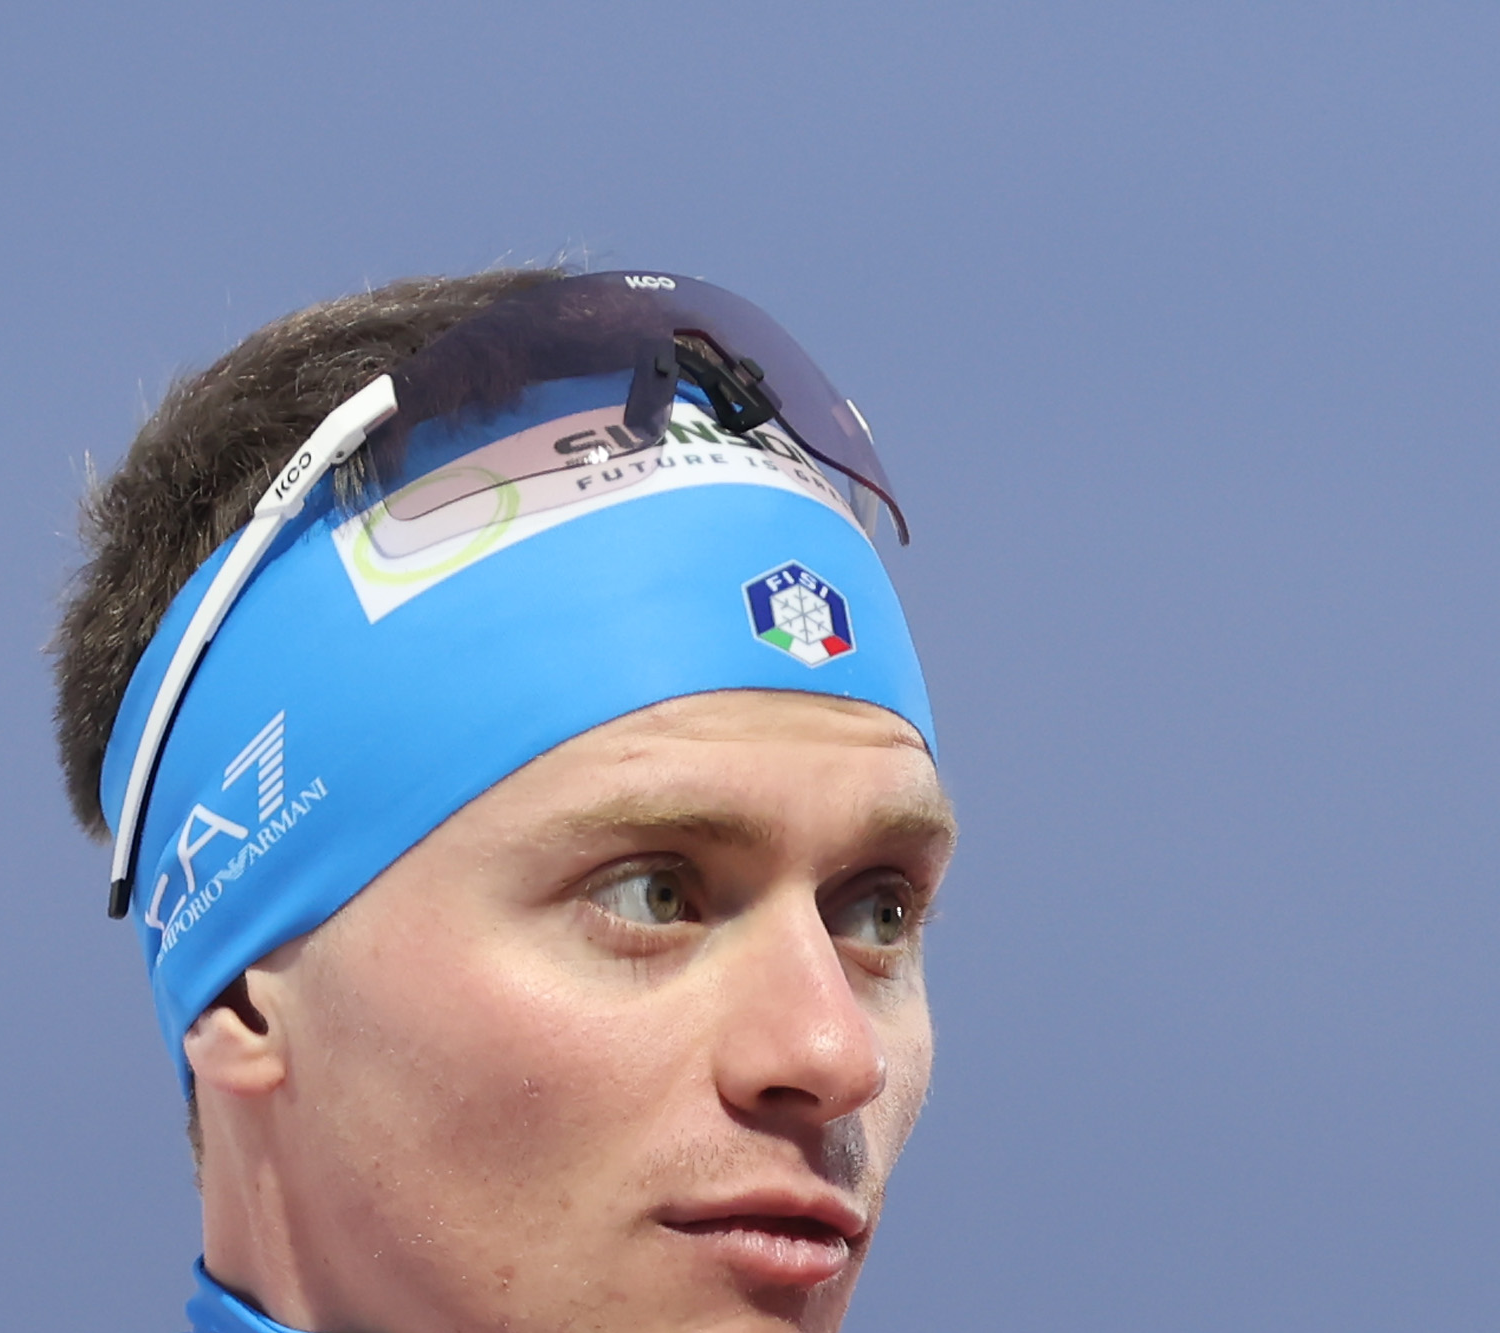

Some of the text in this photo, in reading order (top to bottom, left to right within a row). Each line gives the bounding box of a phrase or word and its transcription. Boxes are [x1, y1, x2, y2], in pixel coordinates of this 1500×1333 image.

[576, 453, 729, 491] FUTURE
[765, 570, 829, 599] FISI
[247, 777, 329, 866] ARMANI
